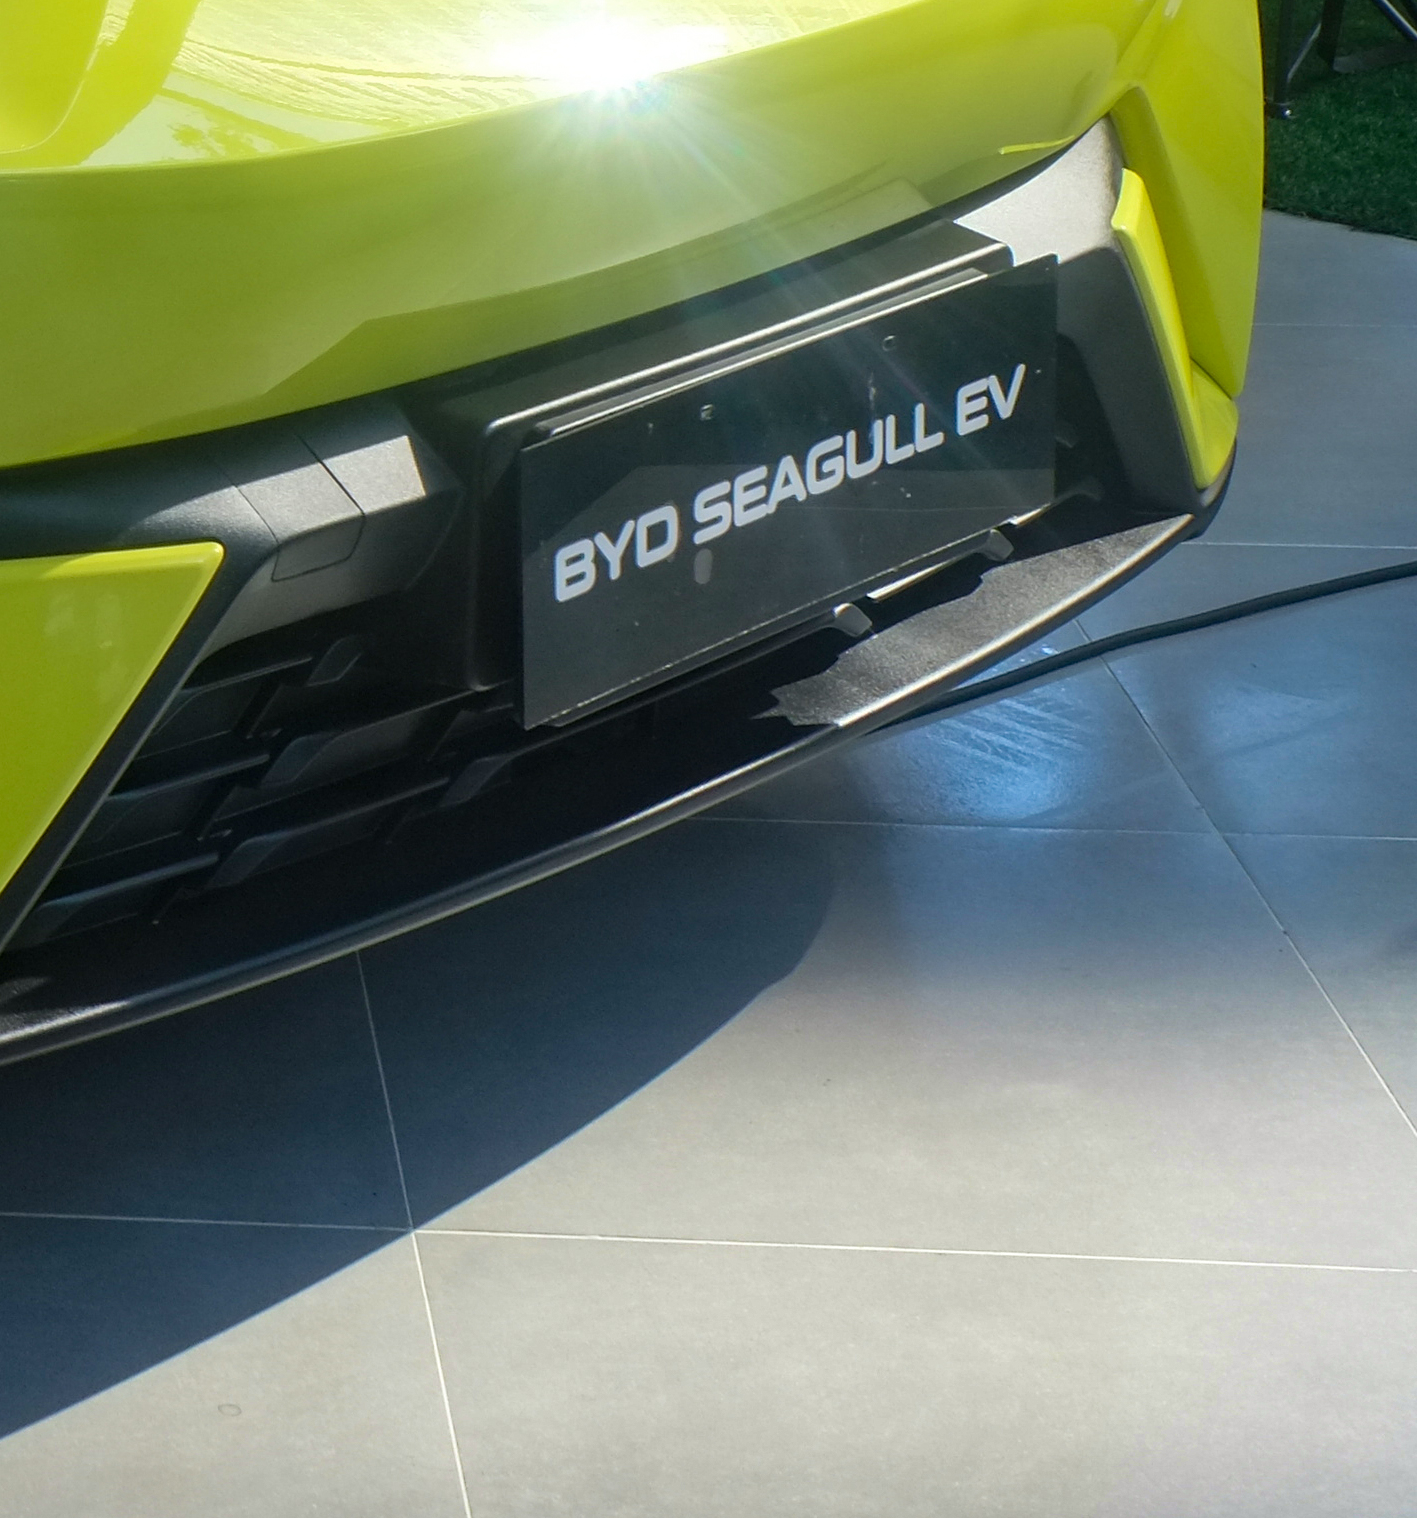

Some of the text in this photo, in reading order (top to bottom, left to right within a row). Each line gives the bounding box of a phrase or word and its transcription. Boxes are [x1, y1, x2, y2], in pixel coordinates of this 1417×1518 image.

[554, 363, 1026, 603] BYD SEAGULL EV
